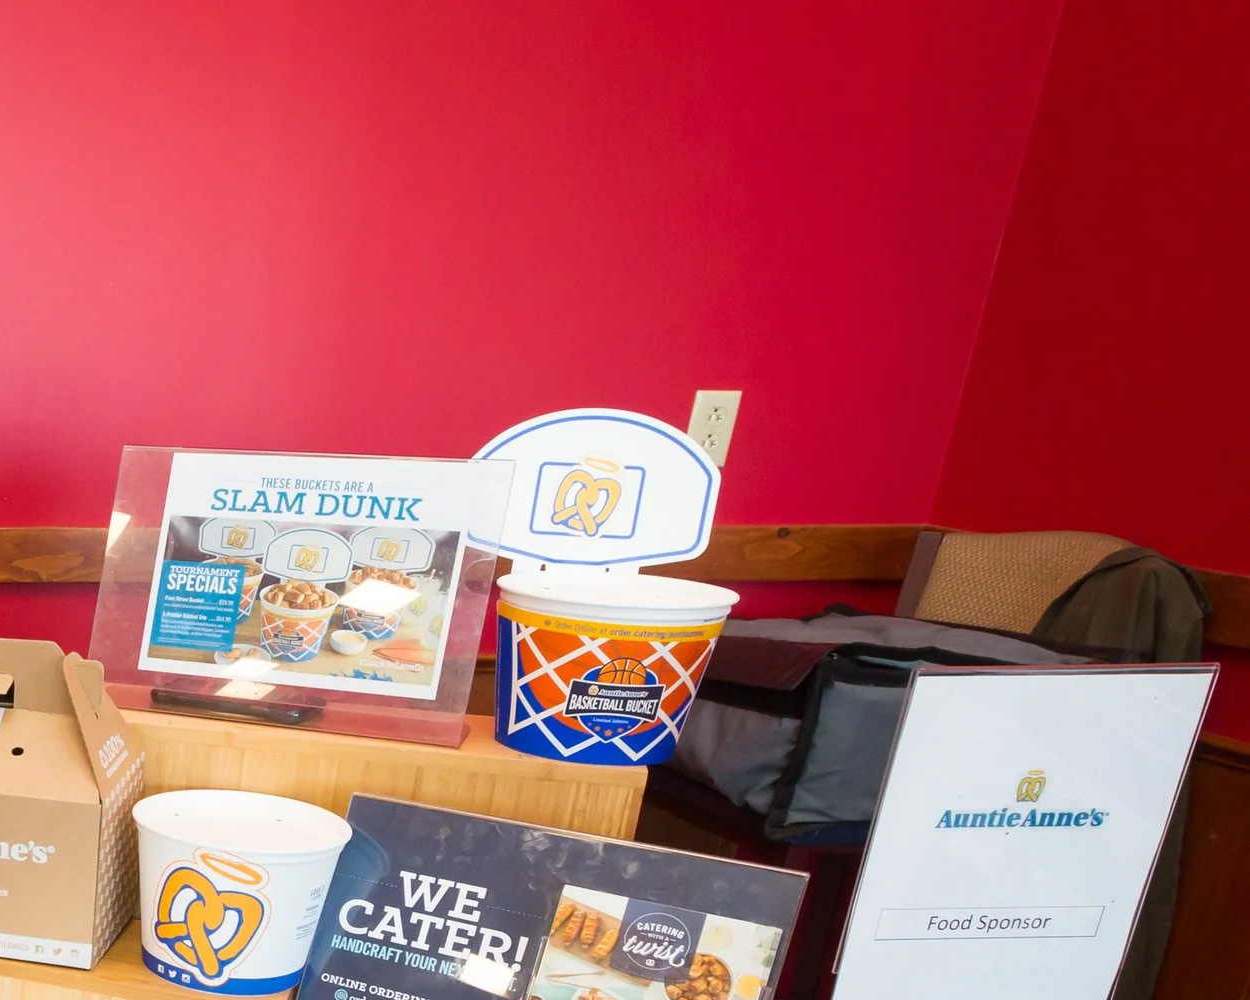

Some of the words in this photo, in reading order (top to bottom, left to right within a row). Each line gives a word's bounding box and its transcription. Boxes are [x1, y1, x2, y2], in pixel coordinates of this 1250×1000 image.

[261, 477, 291, 490] THESE
[295, 478, 341, 492] BUCKETS
[343, 481, 363, 493] ARE
[366, 481, 374, 493] A
[210, 488, 306, 516] SLAM
[315, 492, 423, 522] DUNK
[170, 565, 240, 578] TOURNAMENT
[166, 574, 238, 595] SPECIALS
[554, 620, 572, 630] Order
[569, 694, 624, 711] BASKETBALL
[625, 699, 659, 715] BUCKET
[399, 870, 488, 923] WE
[637, 922, 685, 939] CATERING
[927, 914, 973, 931] Food
[976, 914, 1052, 934] Sponsor
[338, 899, 529, 973] CATER!
[331, 934, 403, 964] HANDCRAFT
[403, 952, 438, 972] YOUR
[622, 935, 686, 968] twist
[321, 973, 367, 992] ONLINE
